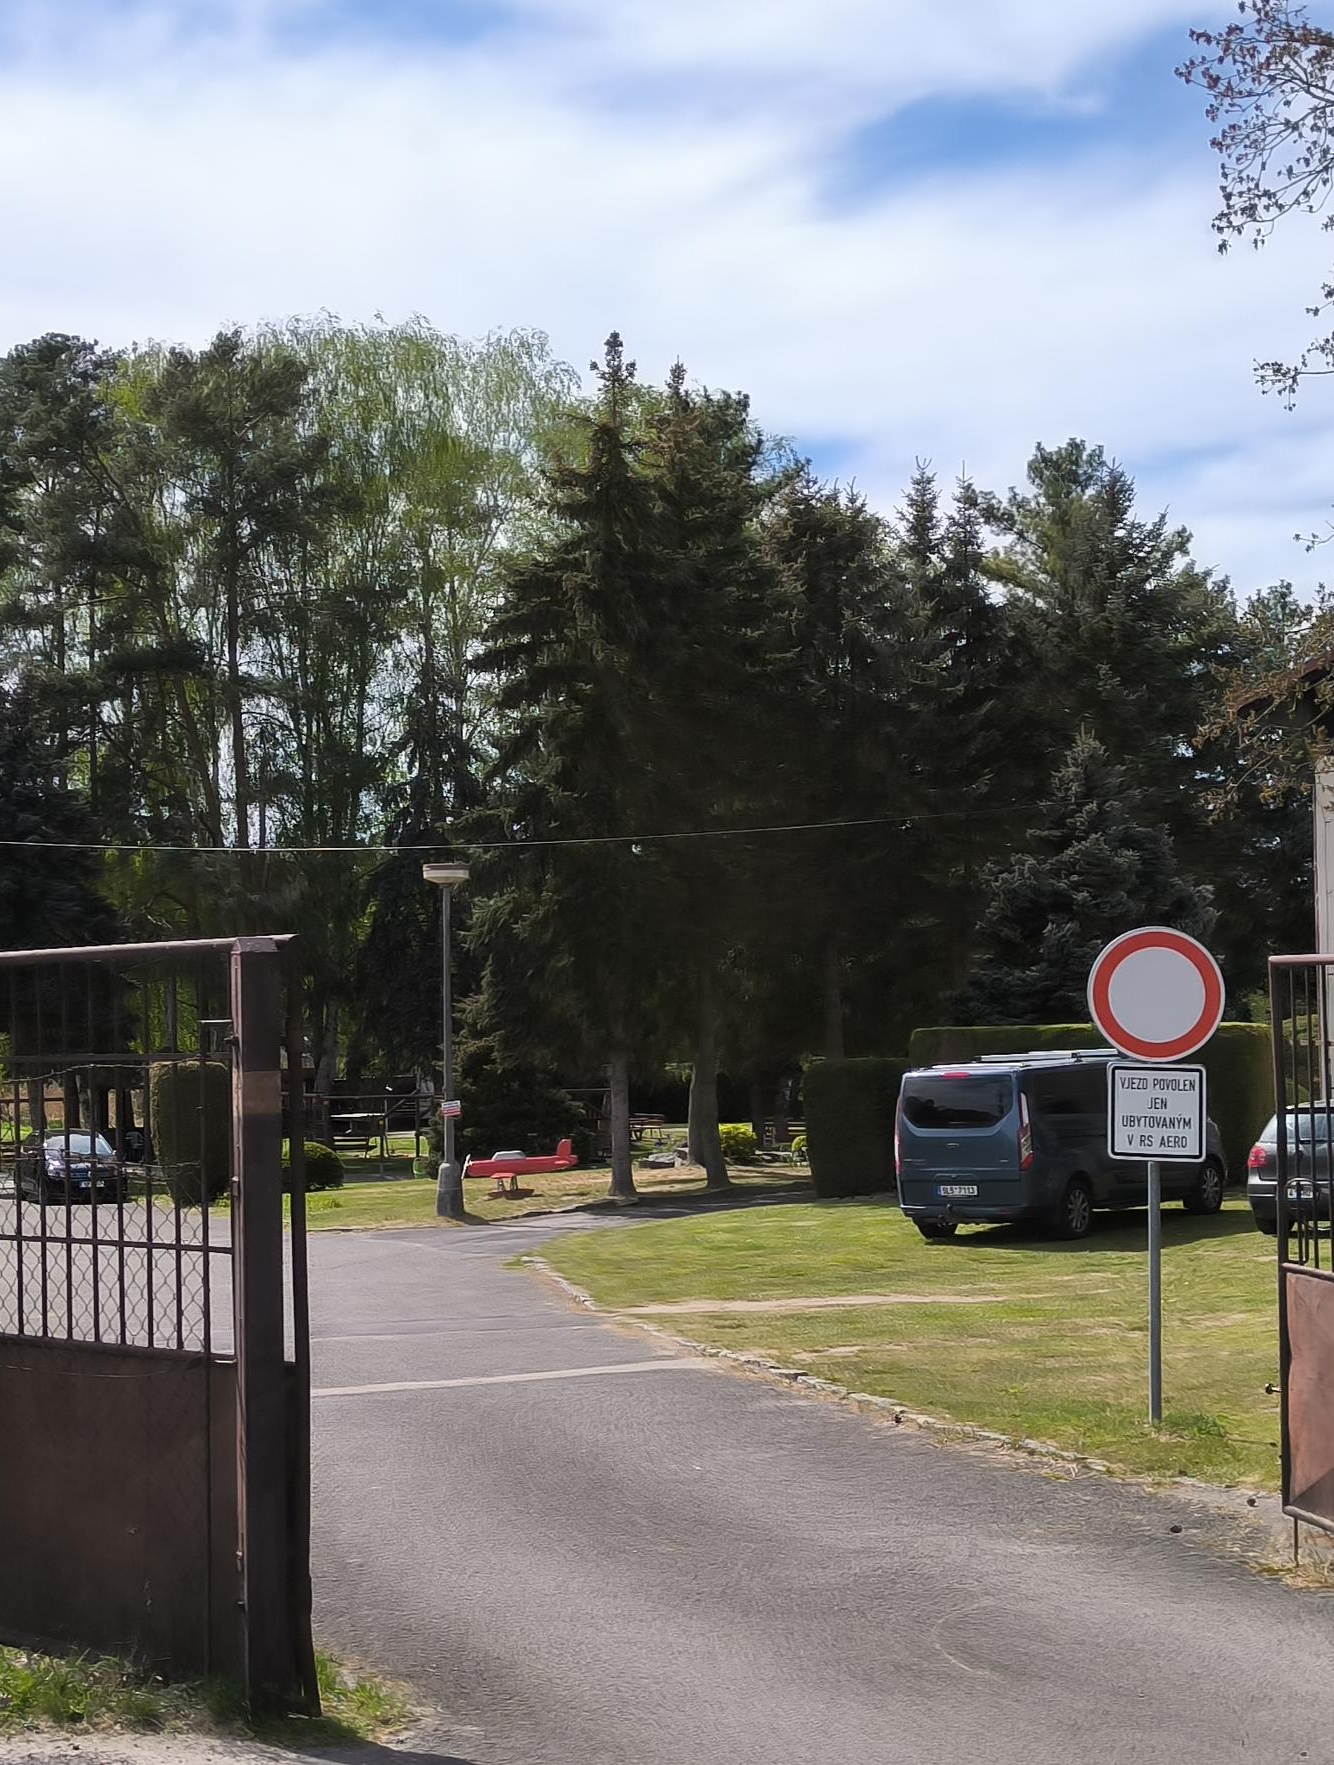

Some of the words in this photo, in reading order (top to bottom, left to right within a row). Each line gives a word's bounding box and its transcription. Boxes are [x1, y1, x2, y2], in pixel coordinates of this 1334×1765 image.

[1120, 1077, 1148, 1090] VJEZD
[1153, 1077, 1195, 1091] POVOLEN
[1148, 1098, 1167, 1110] JEN
[1122, 1113, 1192, 1130] UBYTOVANÝM
[1127, 1134, 1134, 1146] V
[1139, 1134, 1154, 1147] RS
[1159, 1135, 1187, 1149] AERO
